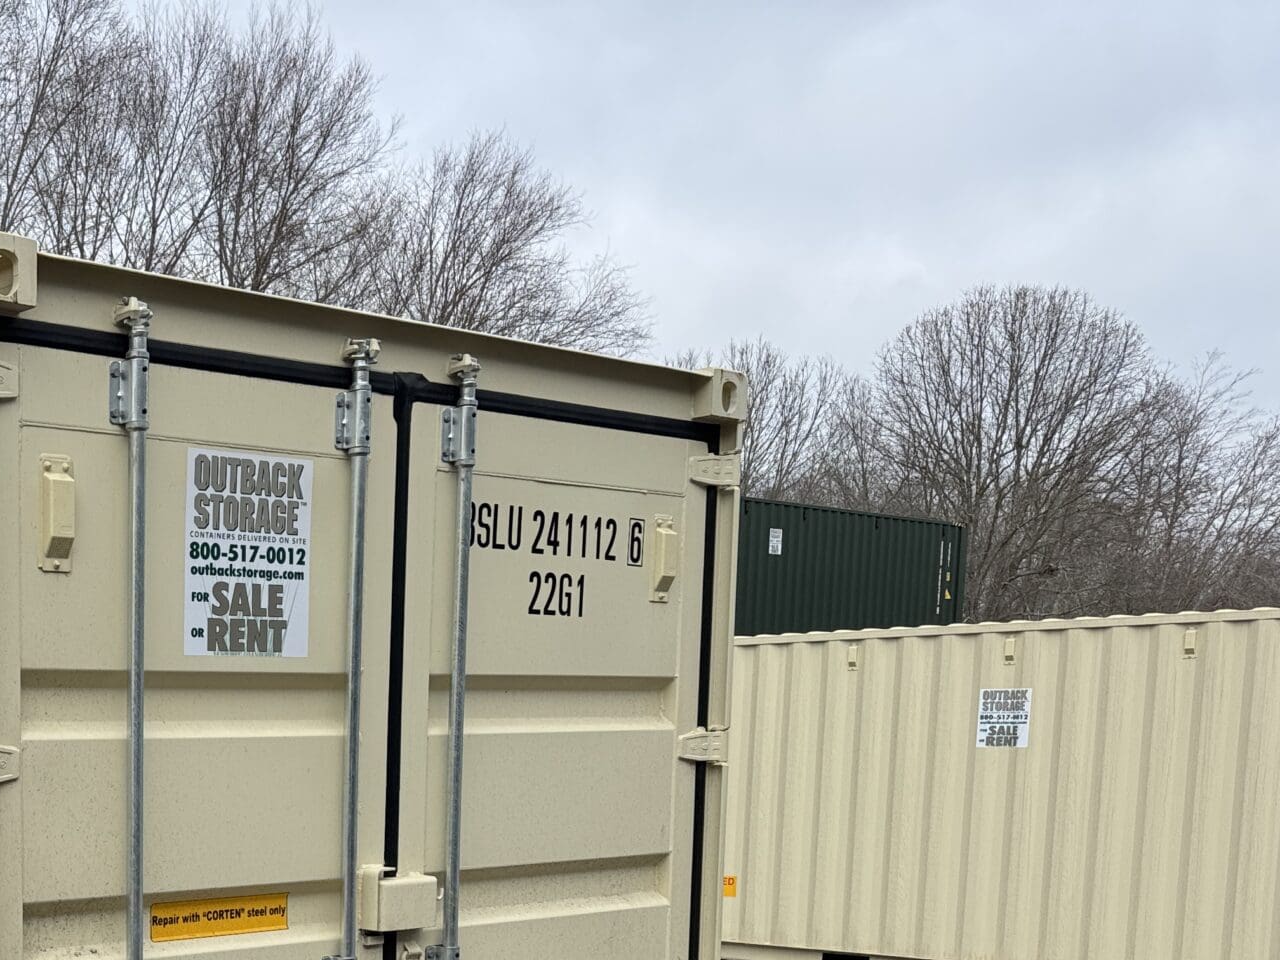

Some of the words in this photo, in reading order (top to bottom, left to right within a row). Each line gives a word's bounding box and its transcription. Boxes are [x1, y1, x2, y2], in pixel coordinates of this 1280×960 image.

[193, 453, 305, 500] OUTBACK
[193, 492, 299, 536] STORAGE
[190, 532, 235, 541] CONTAINERS
[238, 534, 277, 543] DELIVERED
[530, 510, 617, 561] 241112
[630, 521, 642, 563] 6
[189, 541, 306, 565] 800-517-0012
[190, 562, 304, 581] outbackstorage.com
[191, 591, 209, 602] FOR
[211, 580, 284, 618] SALE
[528, 571, 585, 618] 22G1
[191, 628, 204, 638] OR
[207, 618, 288, 653] RENT
[982, 689, 1028, 701] OUTBACK
[982, 701, 1026, 711] STORAGE
[985, 736, 1019, 746] RENT
[988, 725, 1018, 736] SALE
[152, 914, 179, 928] Repair
[182, 911, 200, 924] with
[247, 905, 267, 918] steel
[269, 904, 286, 917] only
